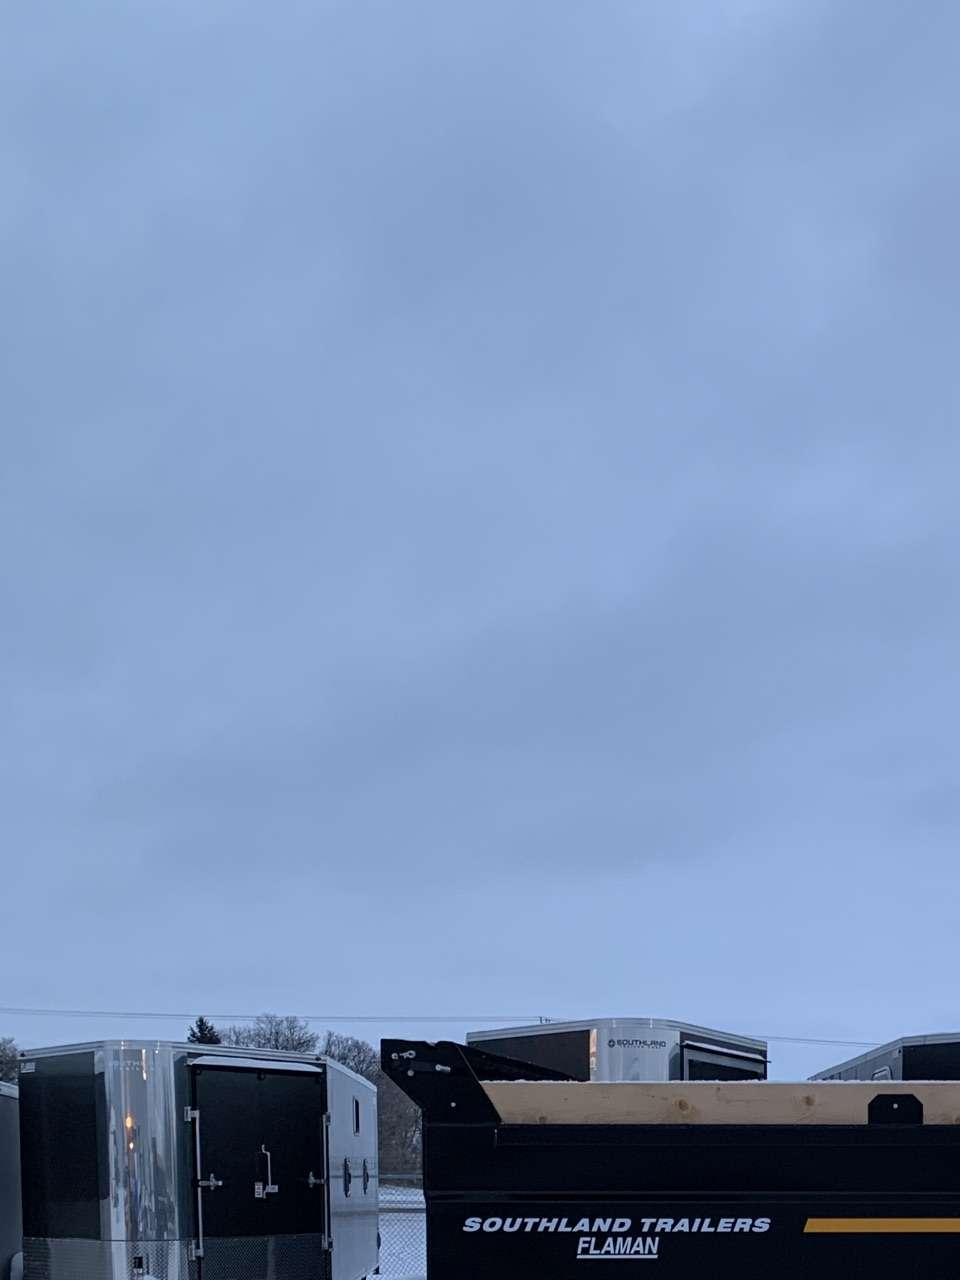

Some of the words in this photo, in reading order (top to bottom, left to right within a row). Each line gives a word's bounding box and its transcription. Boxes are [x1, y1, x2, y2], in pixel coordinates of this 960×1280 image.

[462, 1217, 632, 1233] SOUTHLAND
[640, 1217, 771, 1233] TRAILERS
[577, 1236, 660, 1257] FLAMAN
